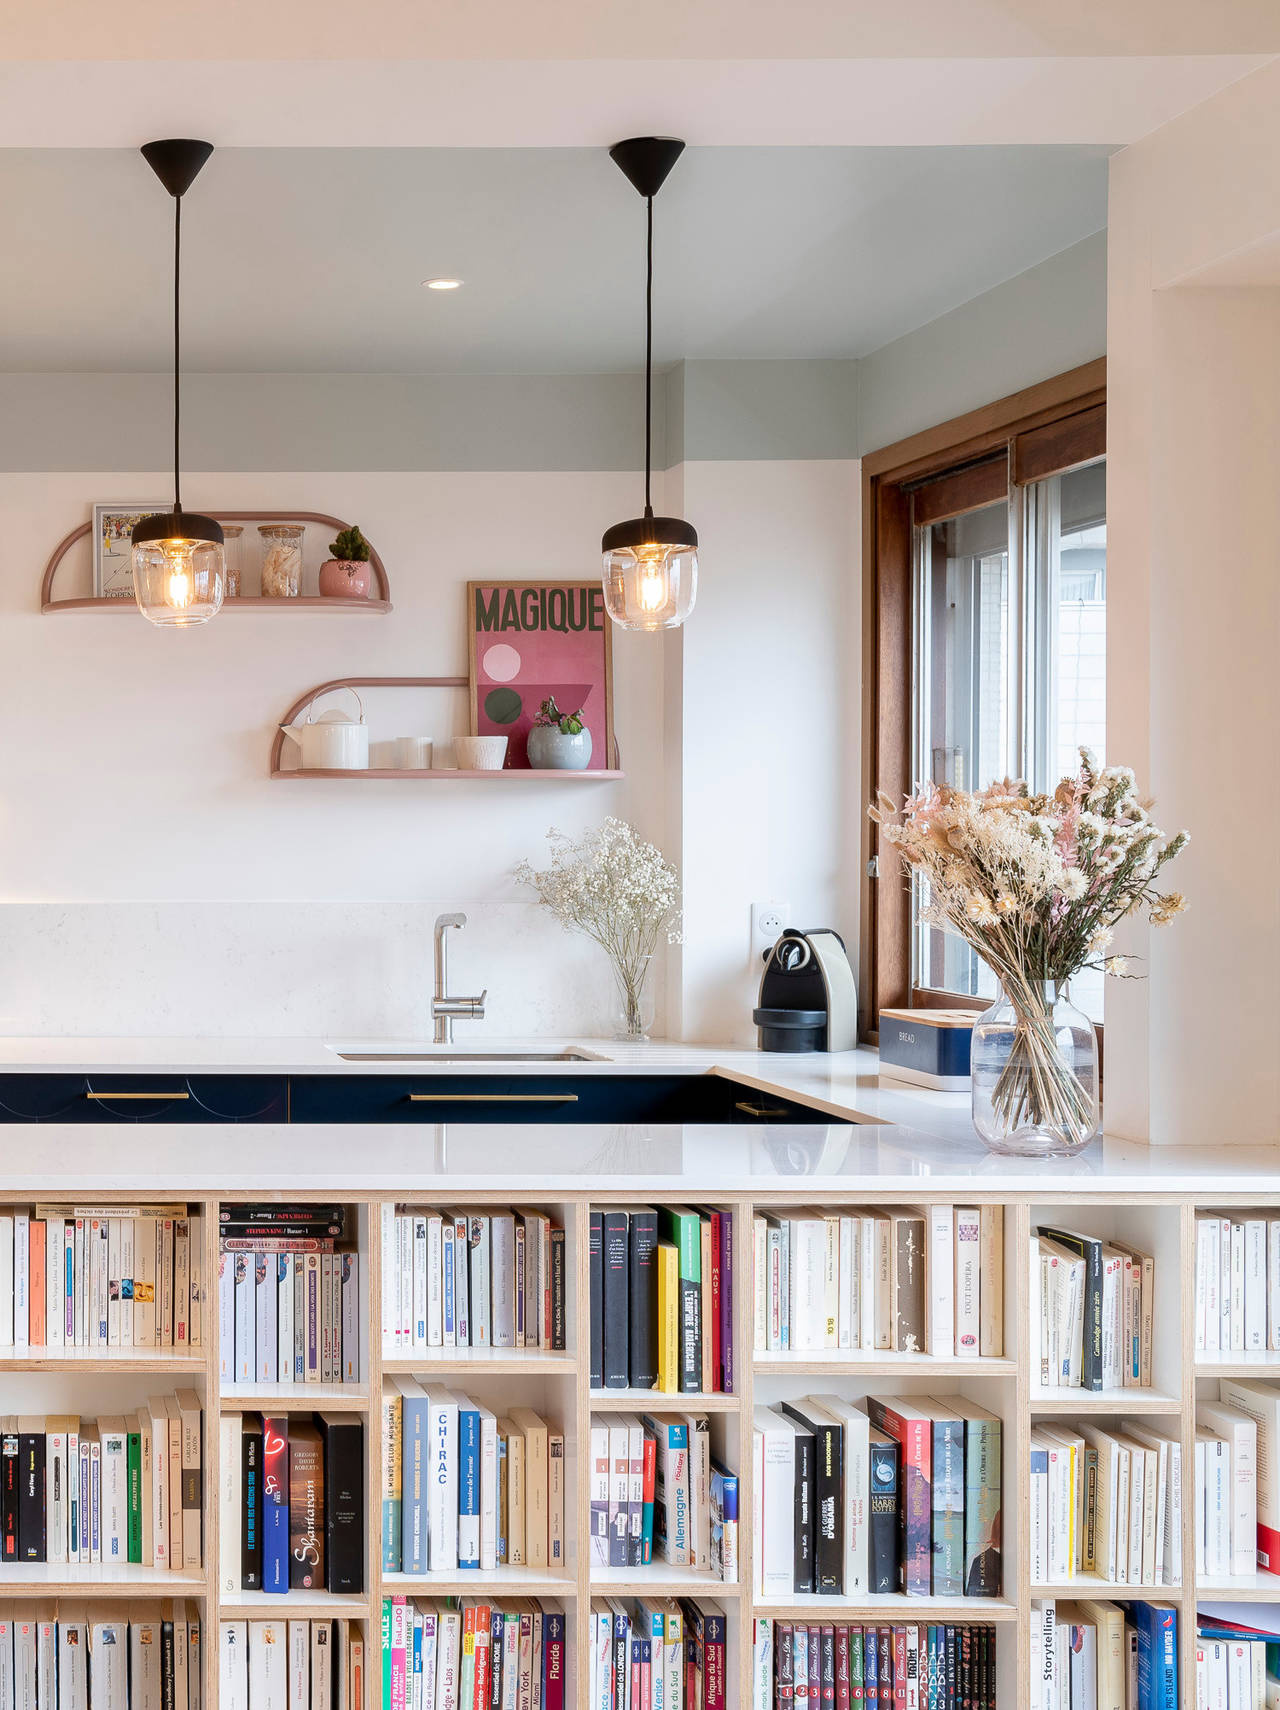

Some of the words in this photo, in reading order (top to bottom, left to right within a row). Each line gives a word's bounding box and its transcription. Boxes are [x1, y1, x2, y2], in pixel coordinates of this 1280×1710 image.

[476, 588, 603, 634] MAGIQUE
[898, 1031, 915, 1044] BREAD
[684, 1290, 694, 1326] L'EMPIRE
[685, 1329, 695, 1372] AMÉRICAIN
[438, 1414, 447, 1484] CHIRAC
[675, 1453, 684, 1481] routard
[294, 1480, 320, 1566] Shantaram
[674, 1488, 686, 1550] Allemagne
[1043, 1609, 1054, 1680] Storytelling
[444, 1668, 453, 1685] Laos
[550, 1644, 559, 1679] Floride
[708, 1663, 715, 1674] du
[521, 1671, 529, 1693] York
[654, 1678, 662, 1710] Venise
[671, 1689, 678, 1701] du
[708, 1675, 716, 1705] Afrique
[826, 1690, 830, 1698] 4
[856, 1689, 860, 1697] 6
[1165, 1669, 1173, 1694] ISLAND
